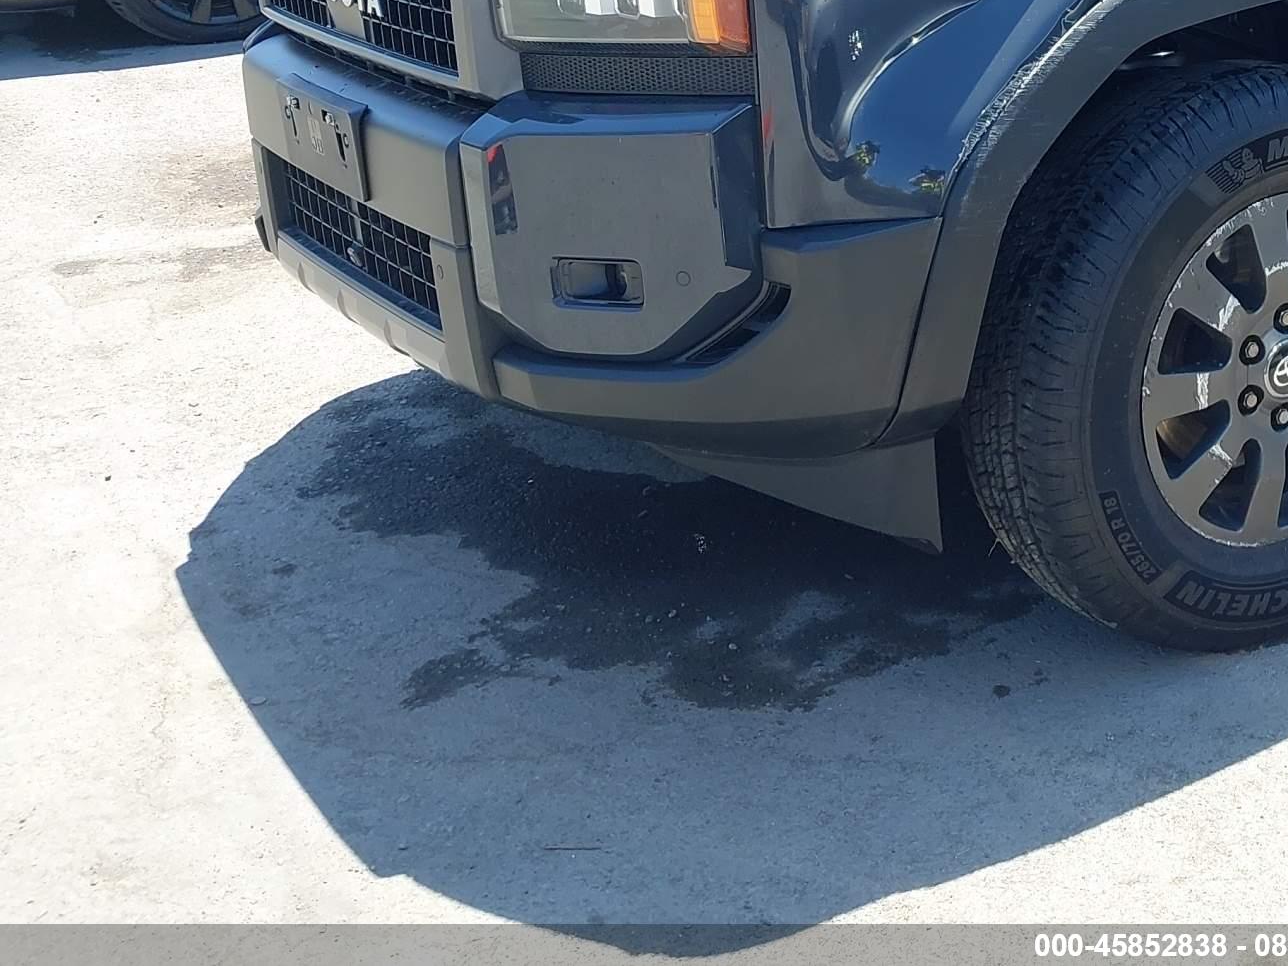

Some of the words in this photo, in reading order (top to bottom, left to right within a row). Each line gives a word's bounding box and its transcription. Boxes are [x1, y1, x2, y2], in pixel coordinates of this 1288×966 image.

[1104, 497, 1119, 515] 18
[1112, 517, 1125, 531] R
[1118, 532, 1156, 579] 265/70
